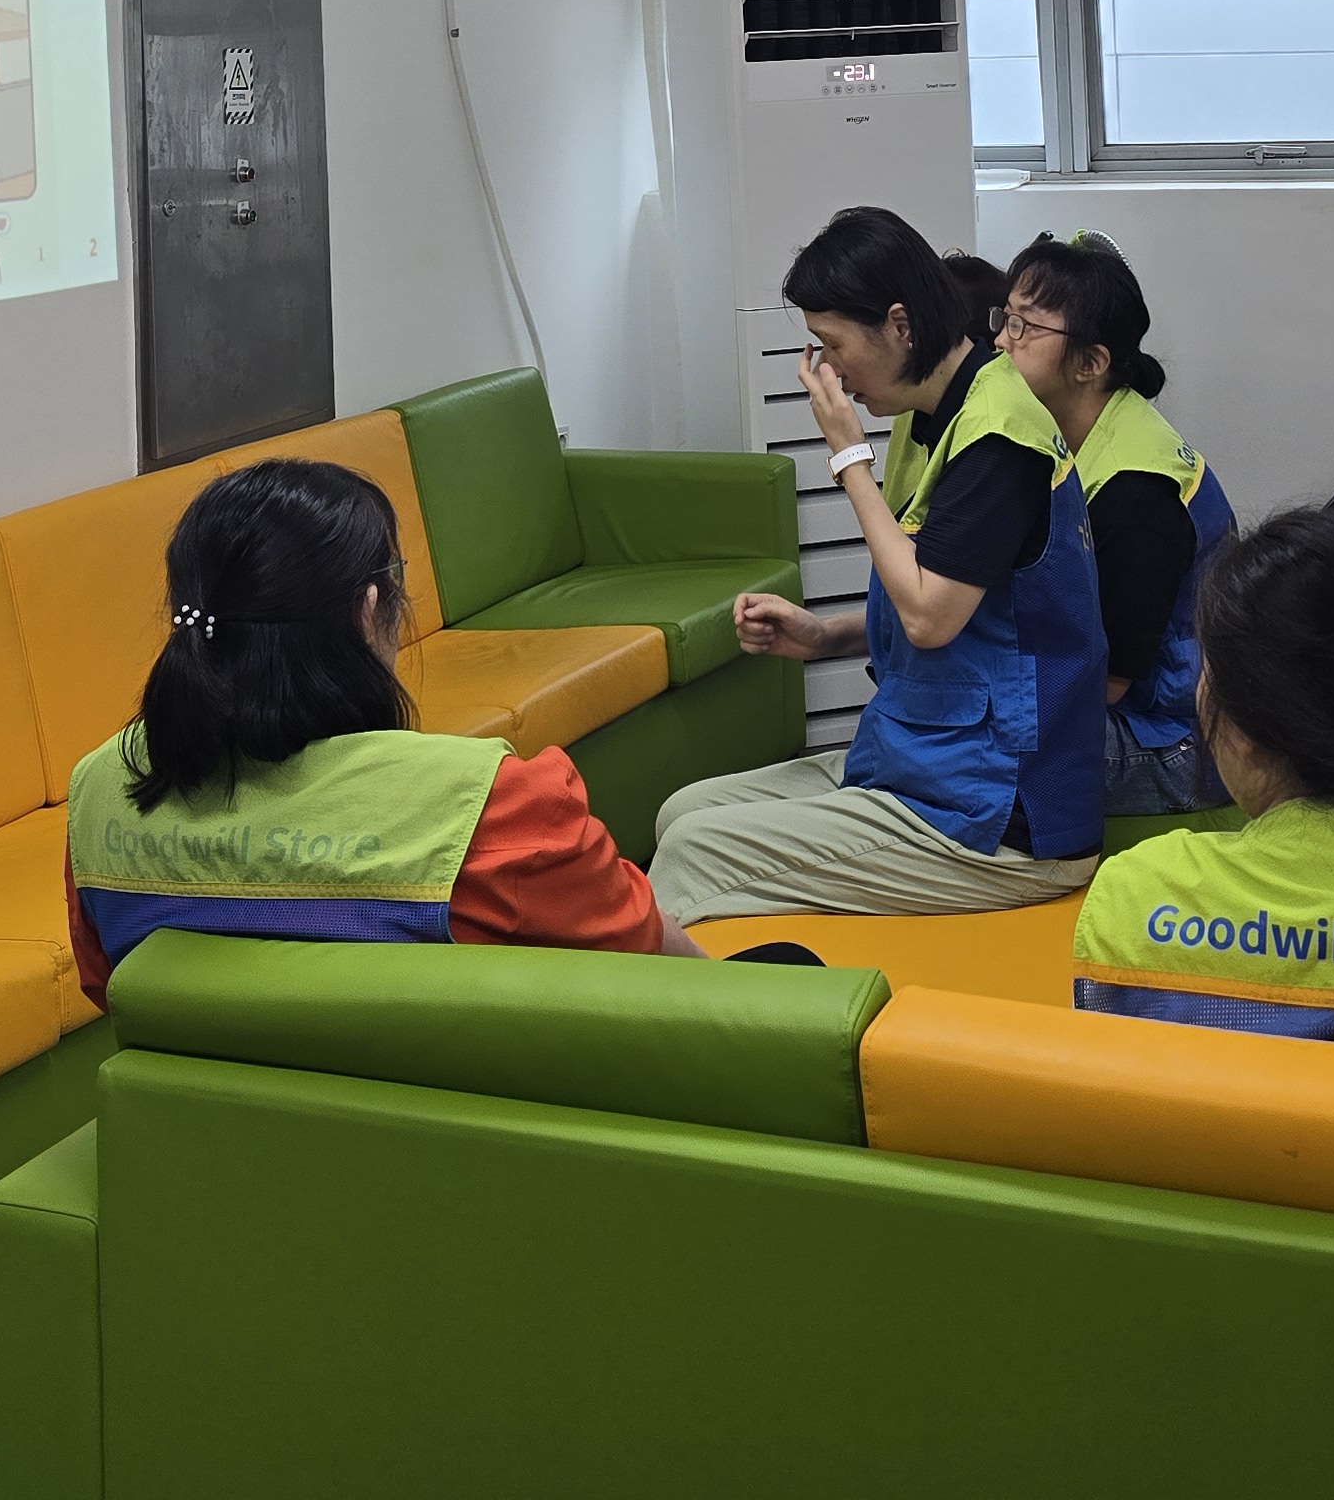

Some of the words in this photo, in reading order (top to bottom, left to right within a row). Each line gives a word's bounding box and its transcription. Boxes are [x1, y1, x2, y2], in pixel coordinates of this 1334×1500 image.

[89, 237, 98, 257] 2
[104, 818, 251, 865] Goodwill
[265, 826, 381, 864] Store
